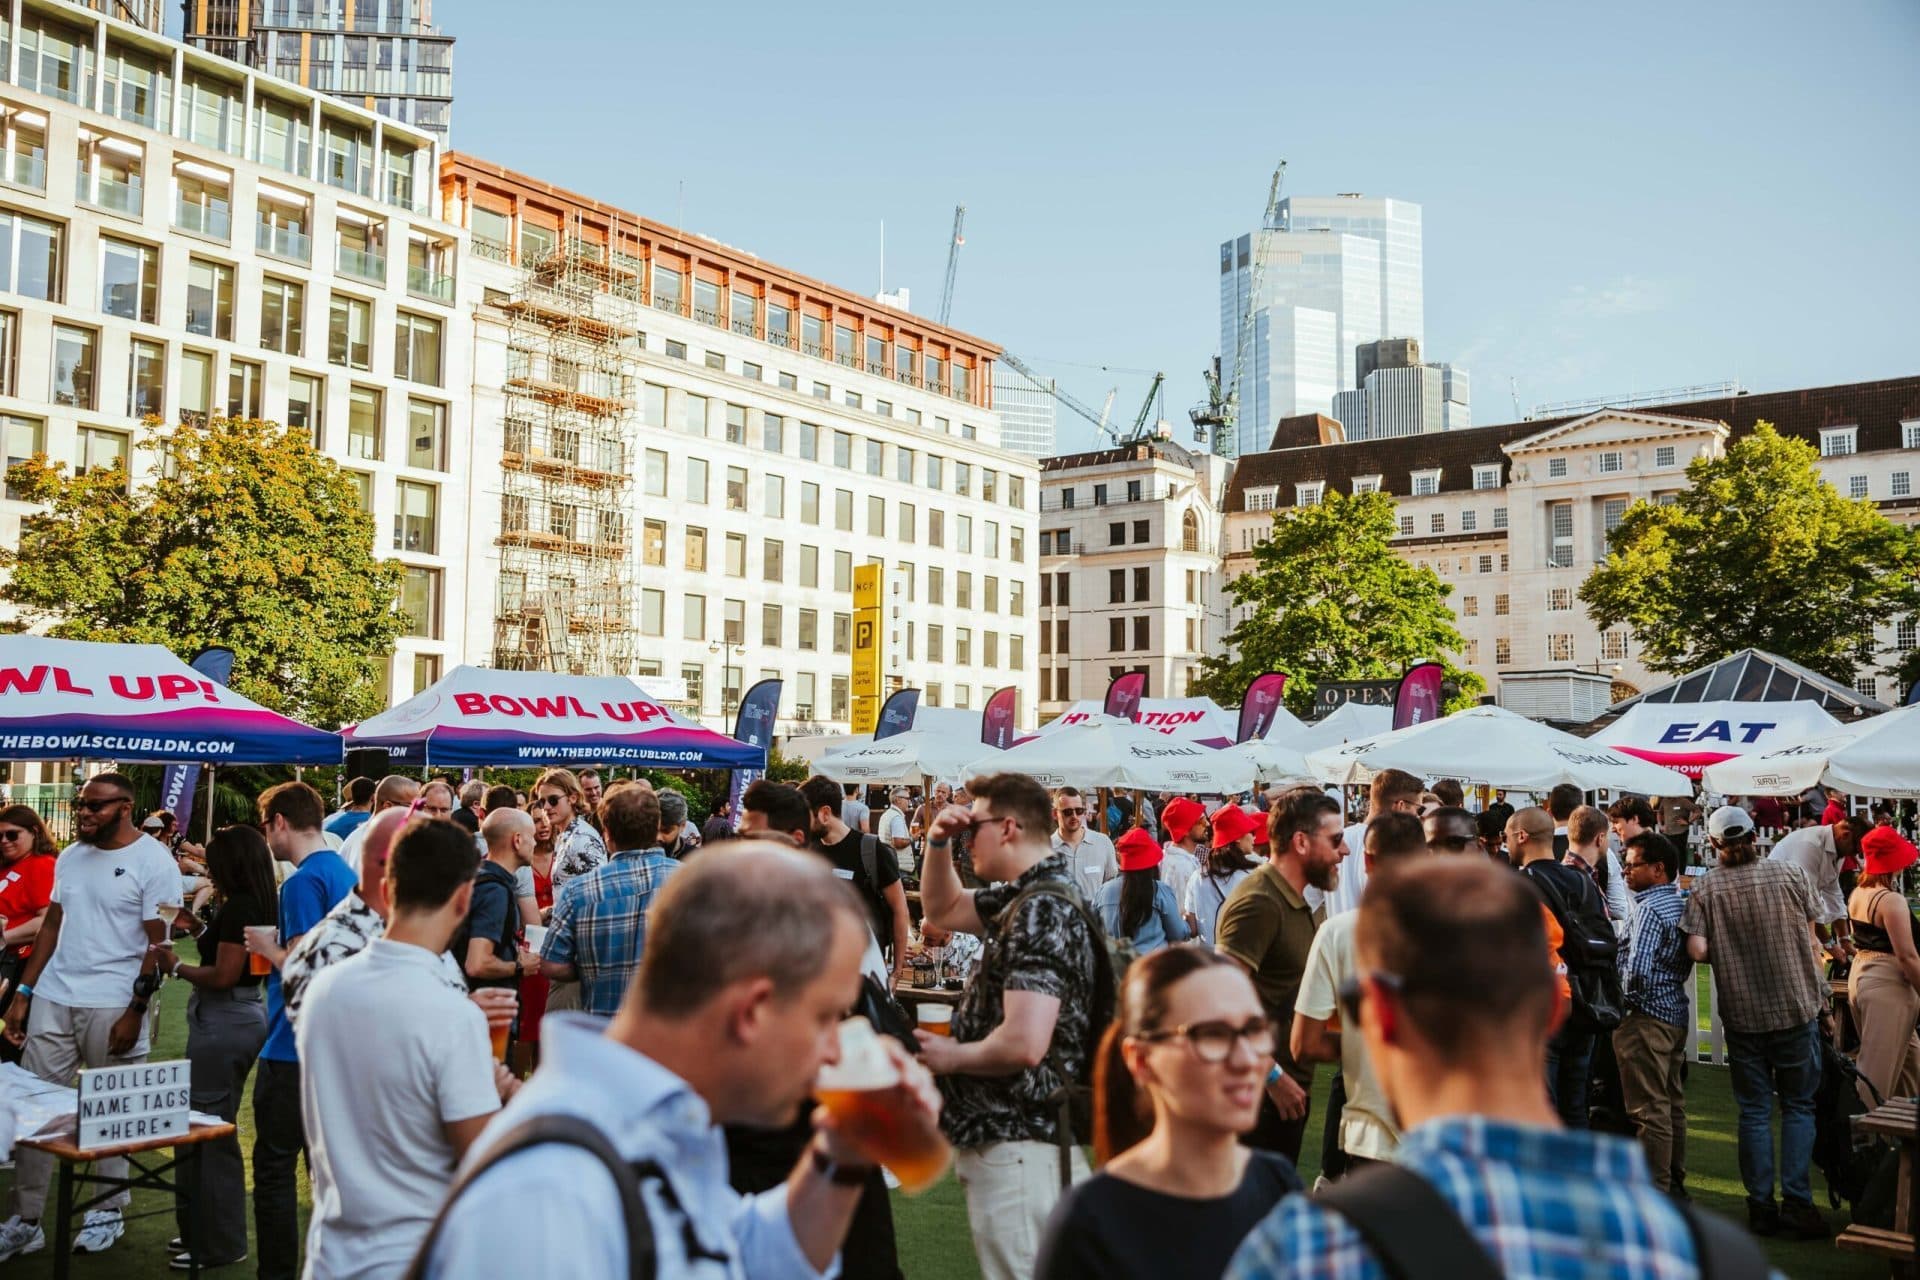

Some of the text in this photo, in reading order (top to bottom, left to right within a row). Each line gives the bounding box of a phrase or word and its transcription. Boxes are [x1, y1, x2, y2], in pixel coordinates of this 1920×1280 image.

[858, 623, 870, 647] P
[109, 674, 220, 703] UP!
[1325, 687, 1393, 704] OPEN
[453, 692, 675, 724] BOWL UP!
[1658, 719, 1777, 743] EAT
[0, 734, 235, 754] HEBOWLSCLUBLDN.COM
[518, 746, 703, 762] WWW.THEBOWLSCLUBLDN.COM
[94, 1066, 180, 1091] COLLECT
[83, 1090, 188, 1118] NAME TAGS
[111, 1118, 158, 1139] HERE
